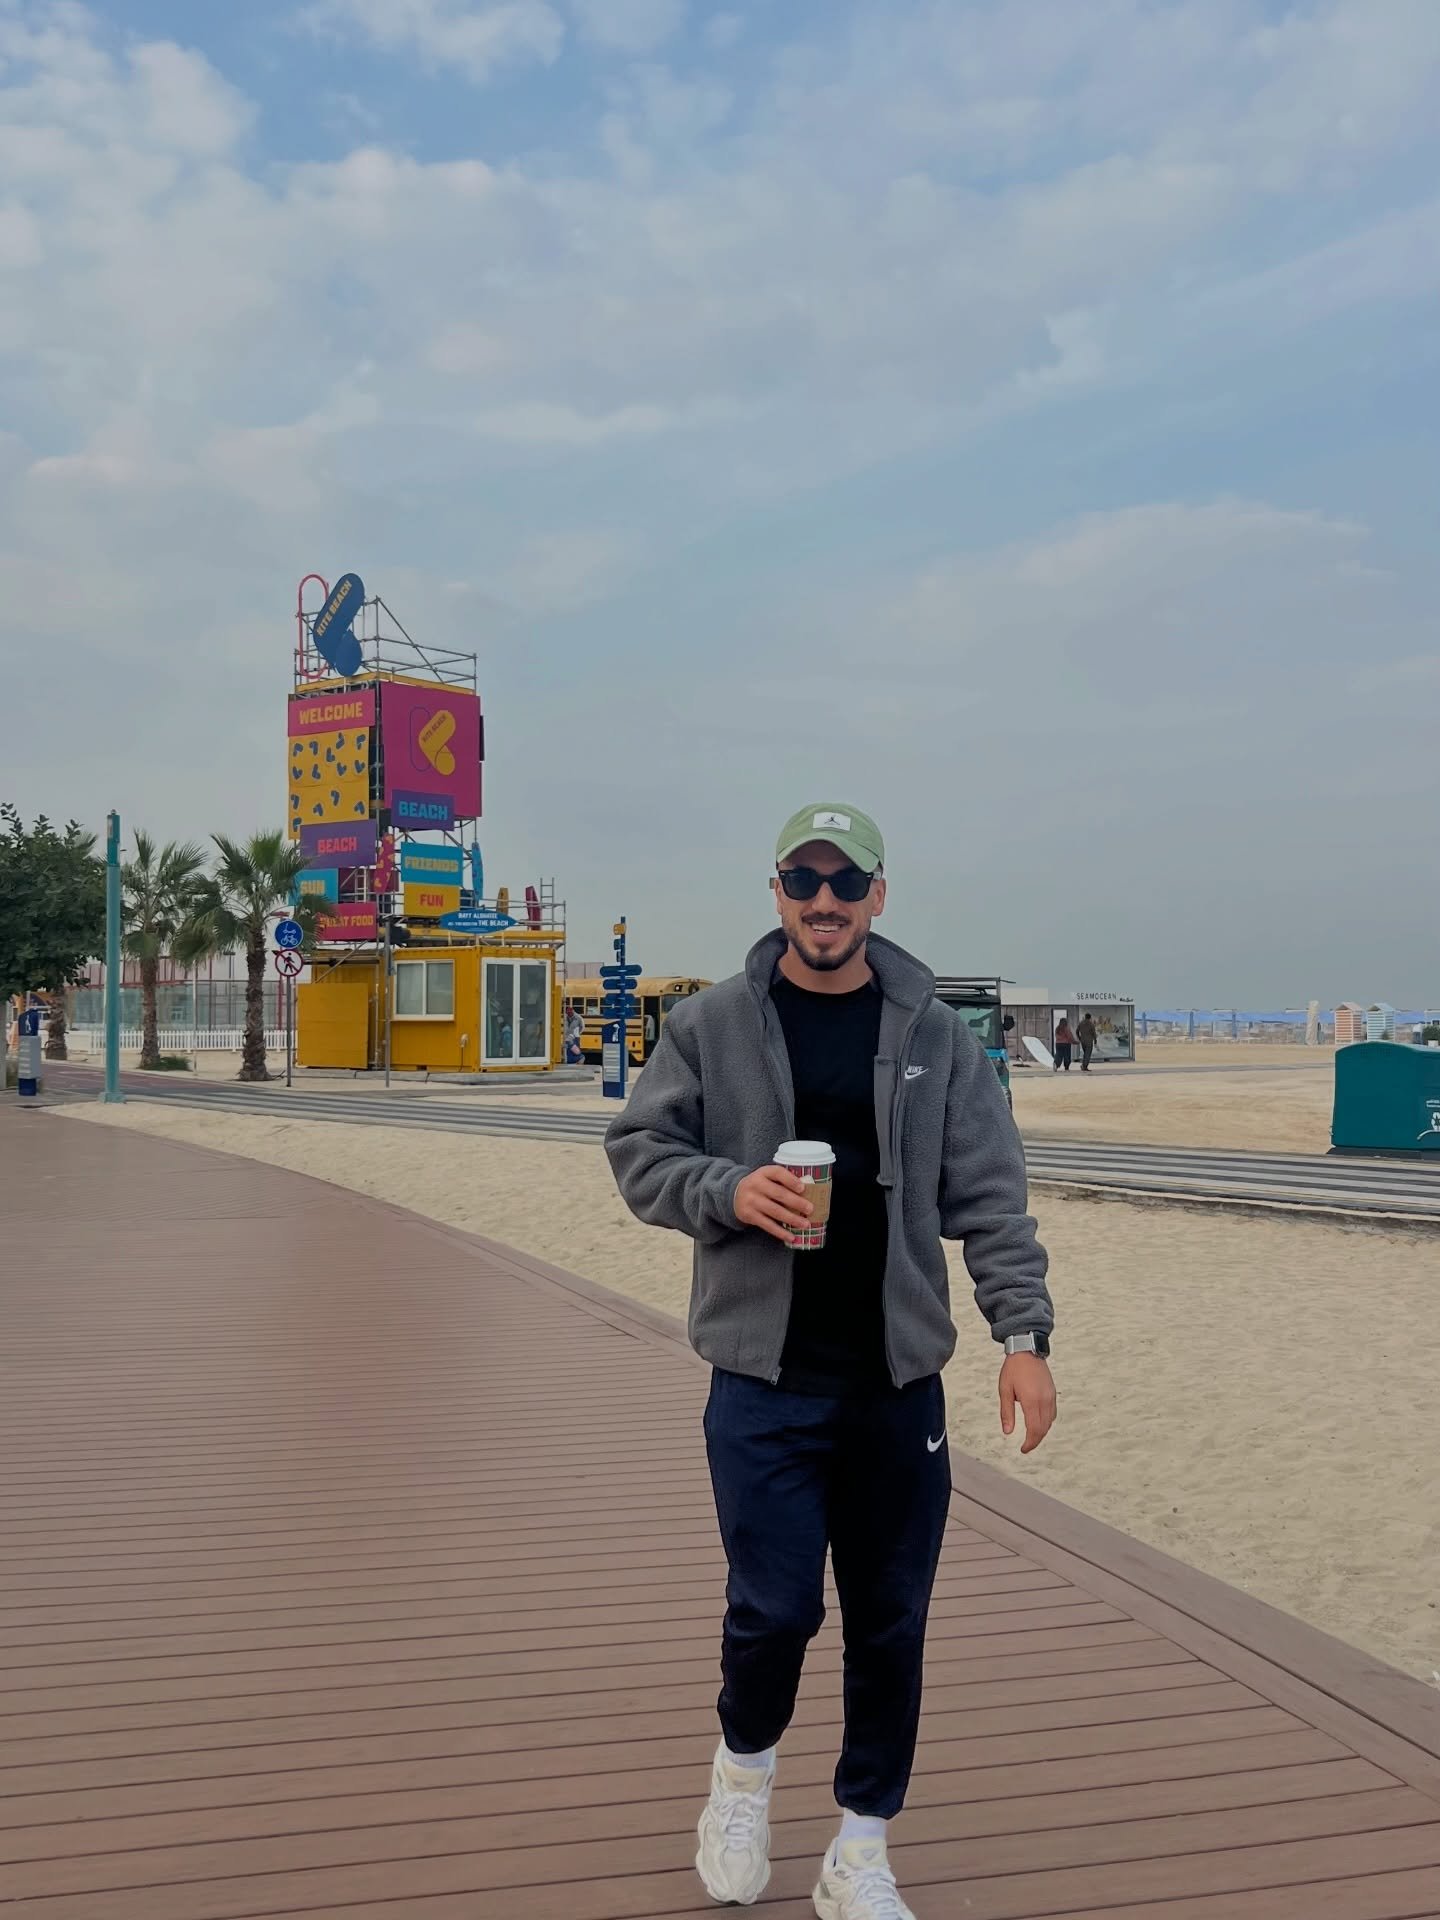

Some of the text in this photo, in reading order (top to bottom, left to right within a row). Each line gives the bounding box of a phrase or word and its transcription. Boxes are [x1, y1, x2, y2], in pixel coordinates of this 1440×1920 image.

[316, 580, 352, 637] KITE BEACH
[299, 701, 363, 725] WELCOME
[398, 800, 448, 820] BEACH
[317, 836, 357, 854] BEACH
[404, 855, 459, 873] FRIENDS
[299, 880, 325, 895] SUN
[420, 894, 444, 908] FUN
[351, 915, 374, 927] FOOD
[1076, 992, 1117, 1000] SEAMOCEAN
